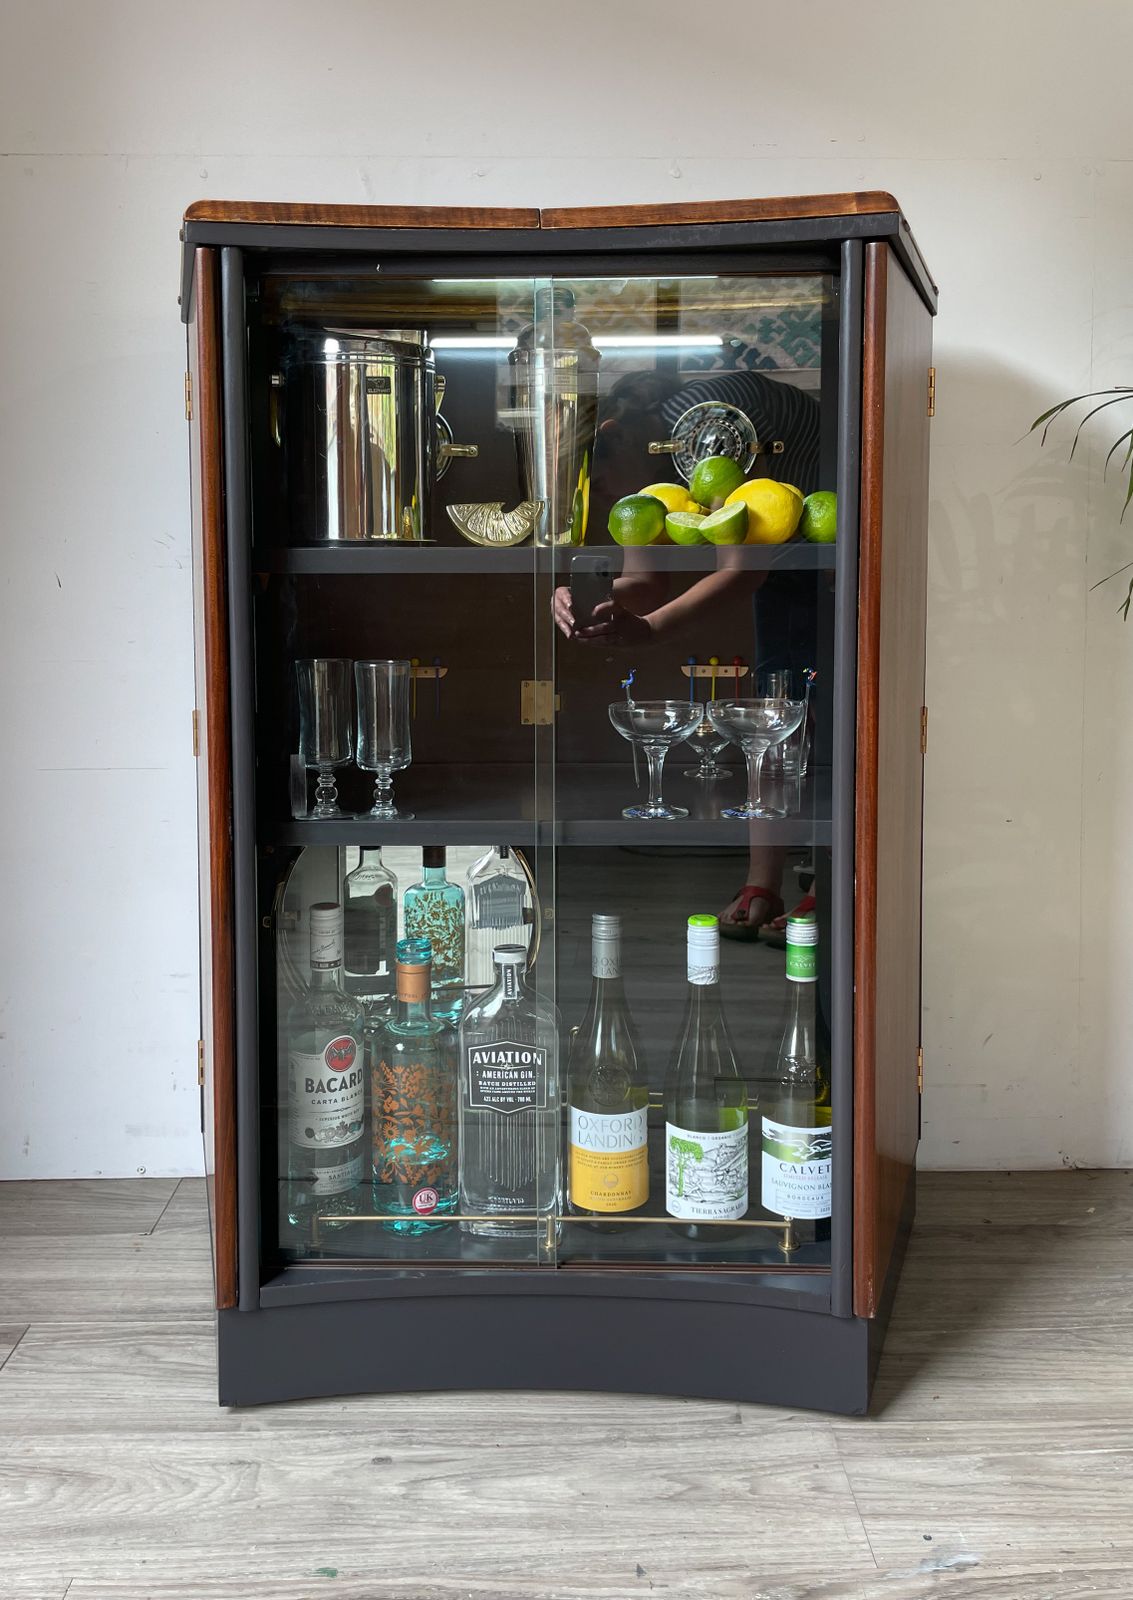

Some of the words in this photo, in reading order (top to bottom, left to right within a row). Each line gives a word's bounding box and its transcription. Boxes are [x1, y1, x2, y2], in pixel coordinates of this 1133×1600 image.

[472, 1051, 542, 1066] AVIATION
[482, 1070, 518, 1079] AMERICAN
[779, 1162, 831, 1175] CALVET
[771, 1177, 816, 1191] SAUVIGNON
